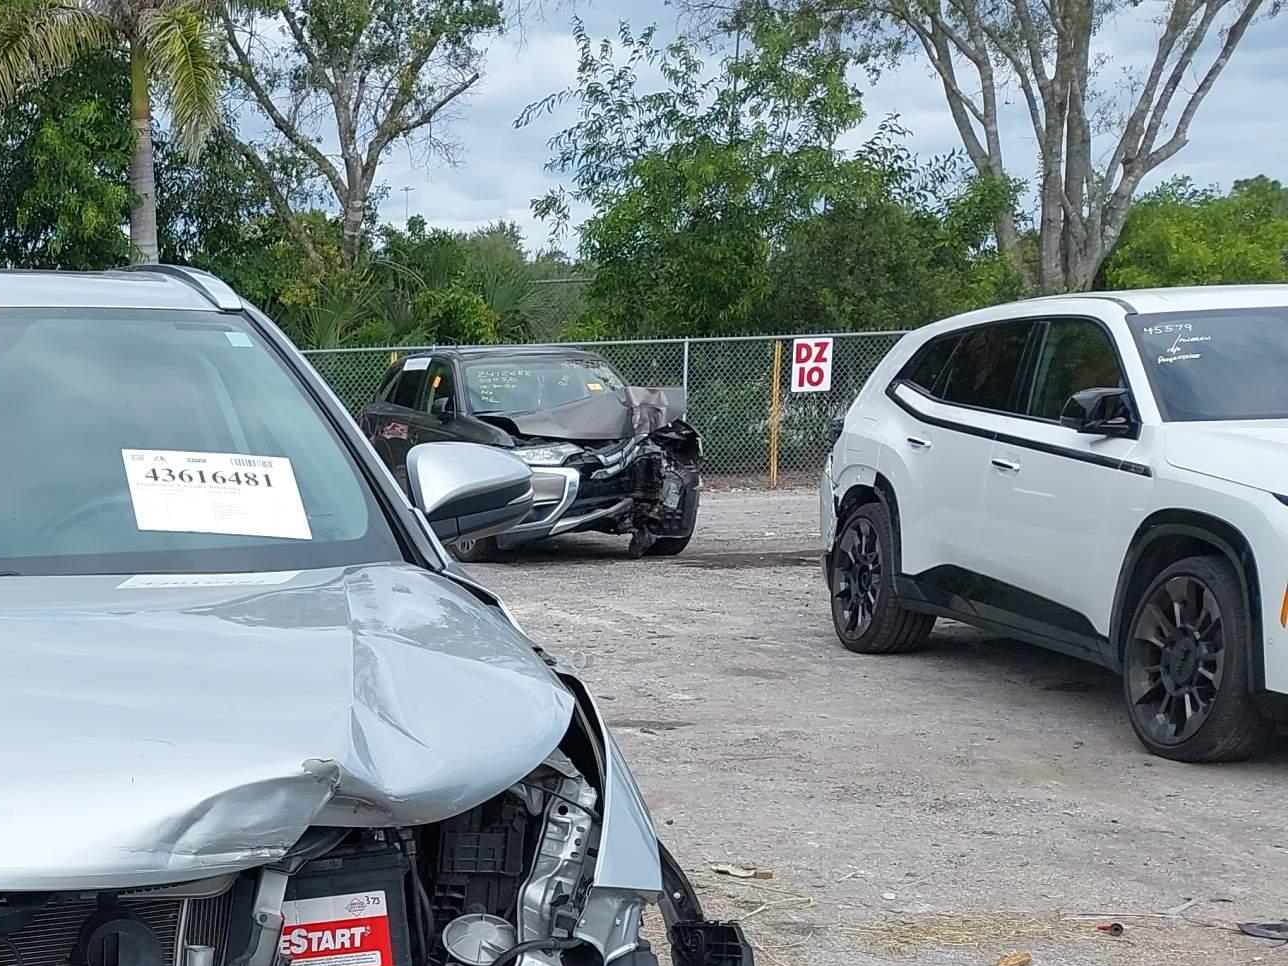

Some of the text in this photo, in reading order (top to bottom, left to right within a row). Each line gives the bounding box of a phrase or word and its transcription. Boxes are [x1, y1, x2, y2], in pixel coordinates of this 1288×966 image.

[1143, 324, 1192, 335] 45579
[795, 342, 829, 364] DZ
[145, 467, 274, 488] 43616481
